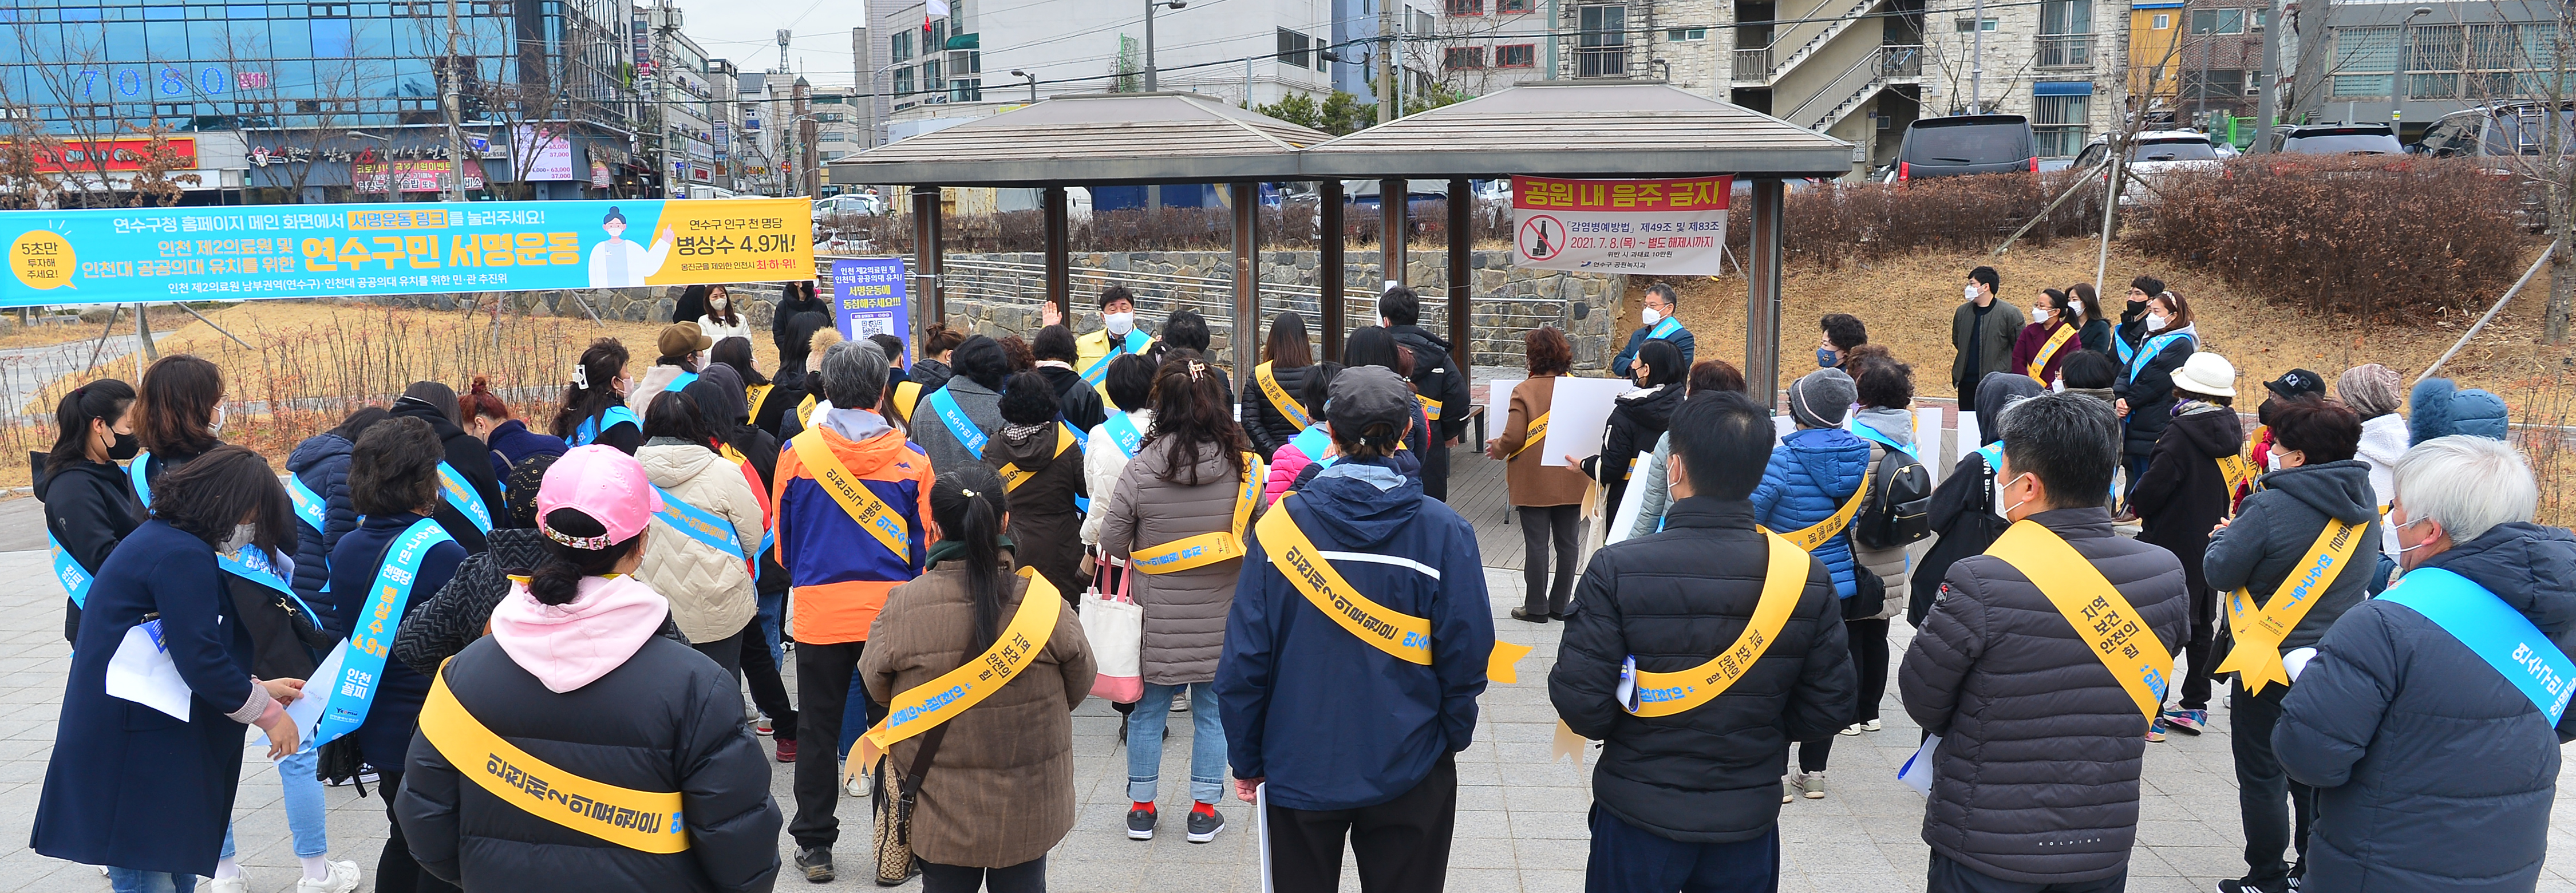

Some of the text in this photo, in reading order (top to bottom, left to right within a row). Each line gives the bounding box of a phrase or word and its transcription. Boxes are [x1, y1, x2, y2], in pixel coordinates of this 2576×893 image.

[1524, 180, 1720, 207] 공원 내 음주 금지
[113, 217, 178, 234] 연수구청
[181, 215, 245, 231] 홈페이지
[248, 215, 279, 230] 메인
[282, 214, 345, 230] 화면에서
[351, 212, 412, 228] 서명운동
[467, 210, 545, 226] 눌러주세요!
[689, 218, 783, 231] 연수구 인구 천 명당
[1640, 222, 1672, 232] 제49조
[1677, 222, 1685, 232] 및
[1688, 221, 1720, 232] 제83조
[21, 242, 58, 255] 5초만
[158, 238, 294, 258] 인천 제2의료원 및
[301, 231, 580, 272] 연수구민 서명운동
[677, 234, 796, 256] 병상수 4.9개!
[1571, 237, 1594, 248] 2021.
[1647, 237, 1666, 249] 별도
[1668, 236, 1713, 248] 해제시까지
[28, 258, 56, 267] 투자해
[82, 256, 295, 278] 인천대 공공의대 유치를 위한
[711, 262, 732, 270] 제외한
[733, 262, 755, 270] 인천시
[756, 259, 796, 270] 최·하·위!
[856, 266, 887, 274] 제2의료원
[27, 270, 58, 279] 주세요!
[168, 282, 189, 294] 인천
[191, 281, 240, 293] 제2의료원
[357, 276, 396, 289] 공공의대
[399, 275, 428, 287] 유치를
[430, 274, 450, 286] 위한
[478, 273, 507, 285] 추진위
[835, 274, 902, 283] 인천대 공공의대 유치!
[848, 285, 891, 296] 서명운동에
[843, 297, 901, 310] 동참해주세요!!!
[946, 409, 973, 439] 연수구민
[966, 432, 985, 451] 천명당
[826, 468, 864, 507] 인천인구
[858, 500, 882, 524] 천명당
[397, 524, 440, 566] 연수구민
[381, 563, 413, 587] 천명당
[1285, 546, 1399, 642] 인천제2의료원은
[2080, 594, 2111, 623] 지역
[2093, 610, 2121, 637] 보건
[1011, 631, 1032, 653] 지역
[1748, 629, 1764, 651] 지역
[2099, 620, 2140, 655] 안전의
[1000, 644, 1021, 665] 보건
[1735, 643, 1752, 665] 보건
[2121, 644, 2141, 660] 힘
[978, 667, 993, 682] 힘
[985, 651, 1012, 680] 안전의
[1717, 654, 1741, 681] 안전의
[2511, 641, 2565, 697] 연수구민
[346, 667, 372, 687] 인천
[1705, 671, 1722, 686] 힘
[341, 681, 368, 700] 꼴찌
[486, 752, 663, 835] 인천제2의료원은
[2039, 837, 2101, 847] KOLPING
